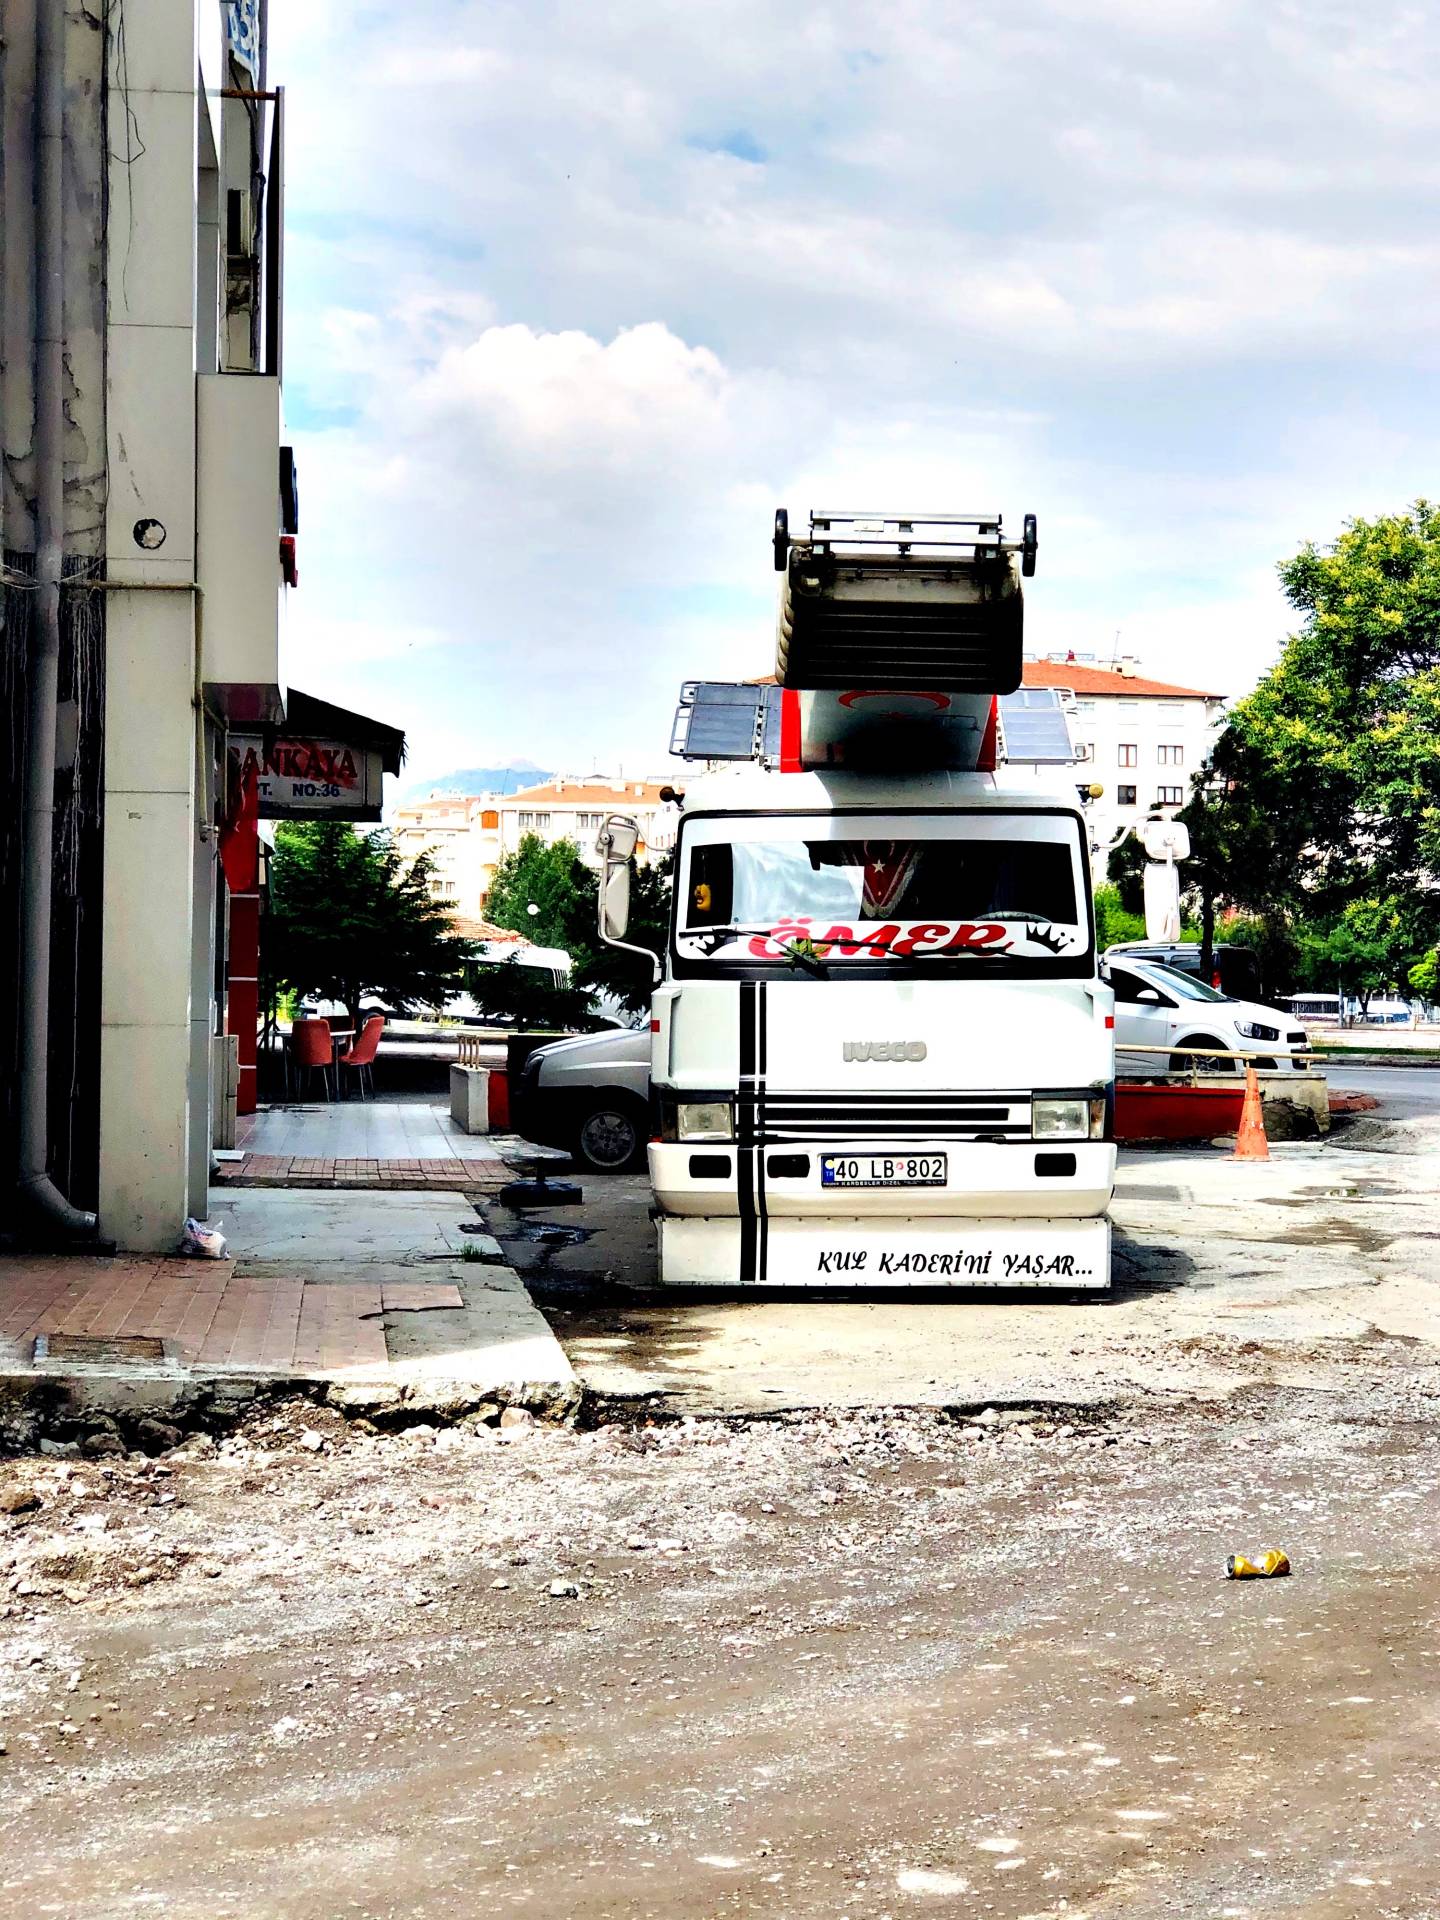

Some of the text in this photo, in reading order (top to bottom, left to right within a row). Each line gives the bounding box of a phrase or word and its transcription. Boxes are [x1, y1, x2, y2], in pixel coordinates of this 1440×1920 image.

[292, 783, 341, 798] NO:36
[747, 917, 1015, 959] ÖMER
[842, 1041, 928, 1062] IVECO
[835, 1159, 942, 1179] 40 LB 802
[817, 1250, 868, 1273] KUL
